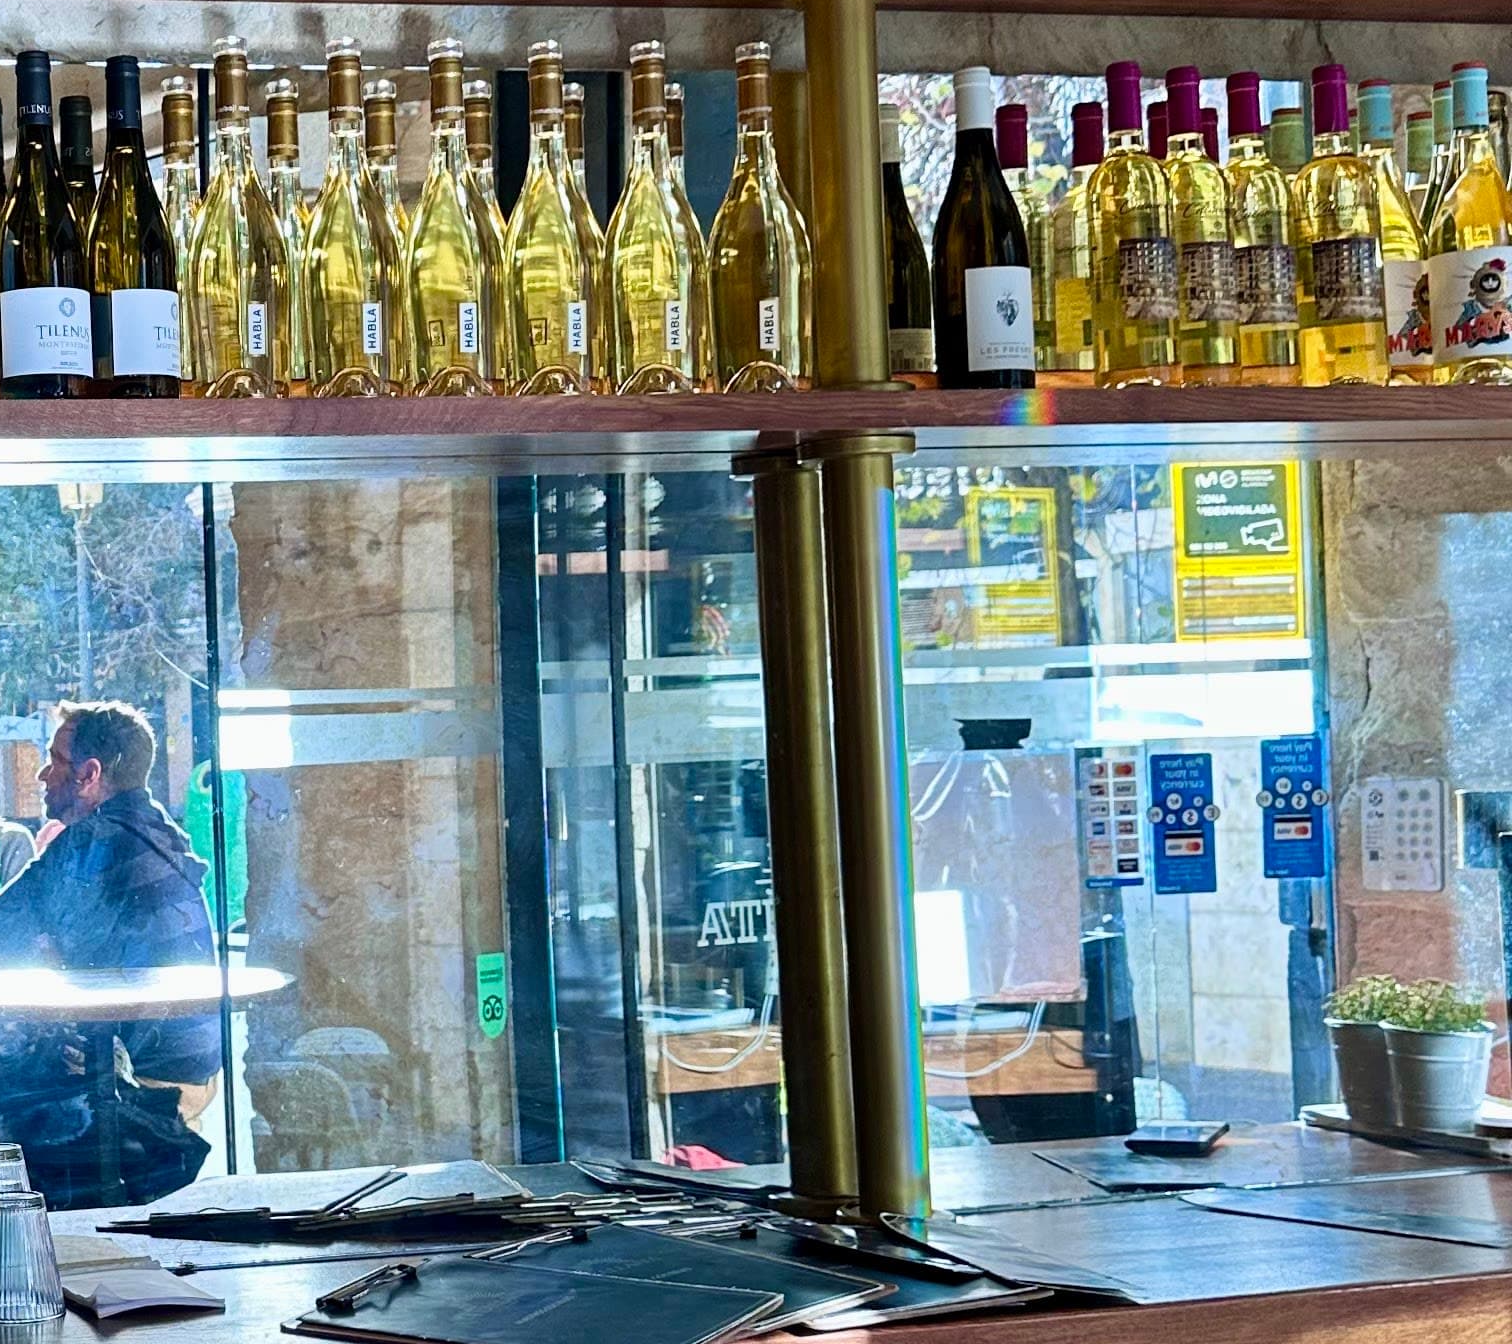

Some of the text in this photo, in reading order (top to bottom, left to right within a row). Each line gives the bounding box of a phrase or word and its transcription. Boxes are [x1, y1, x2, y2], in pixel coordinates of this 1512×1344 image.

[253, 309, 263, 350] HABLA
[367, 308, 377, 349] HABLA
[464, 307, 474, 348] HABLA
[572, 307, 582, 348] HABLA
[670, 305, 680, 346] HABLA
[764, 304, 775, 345] HABLA
